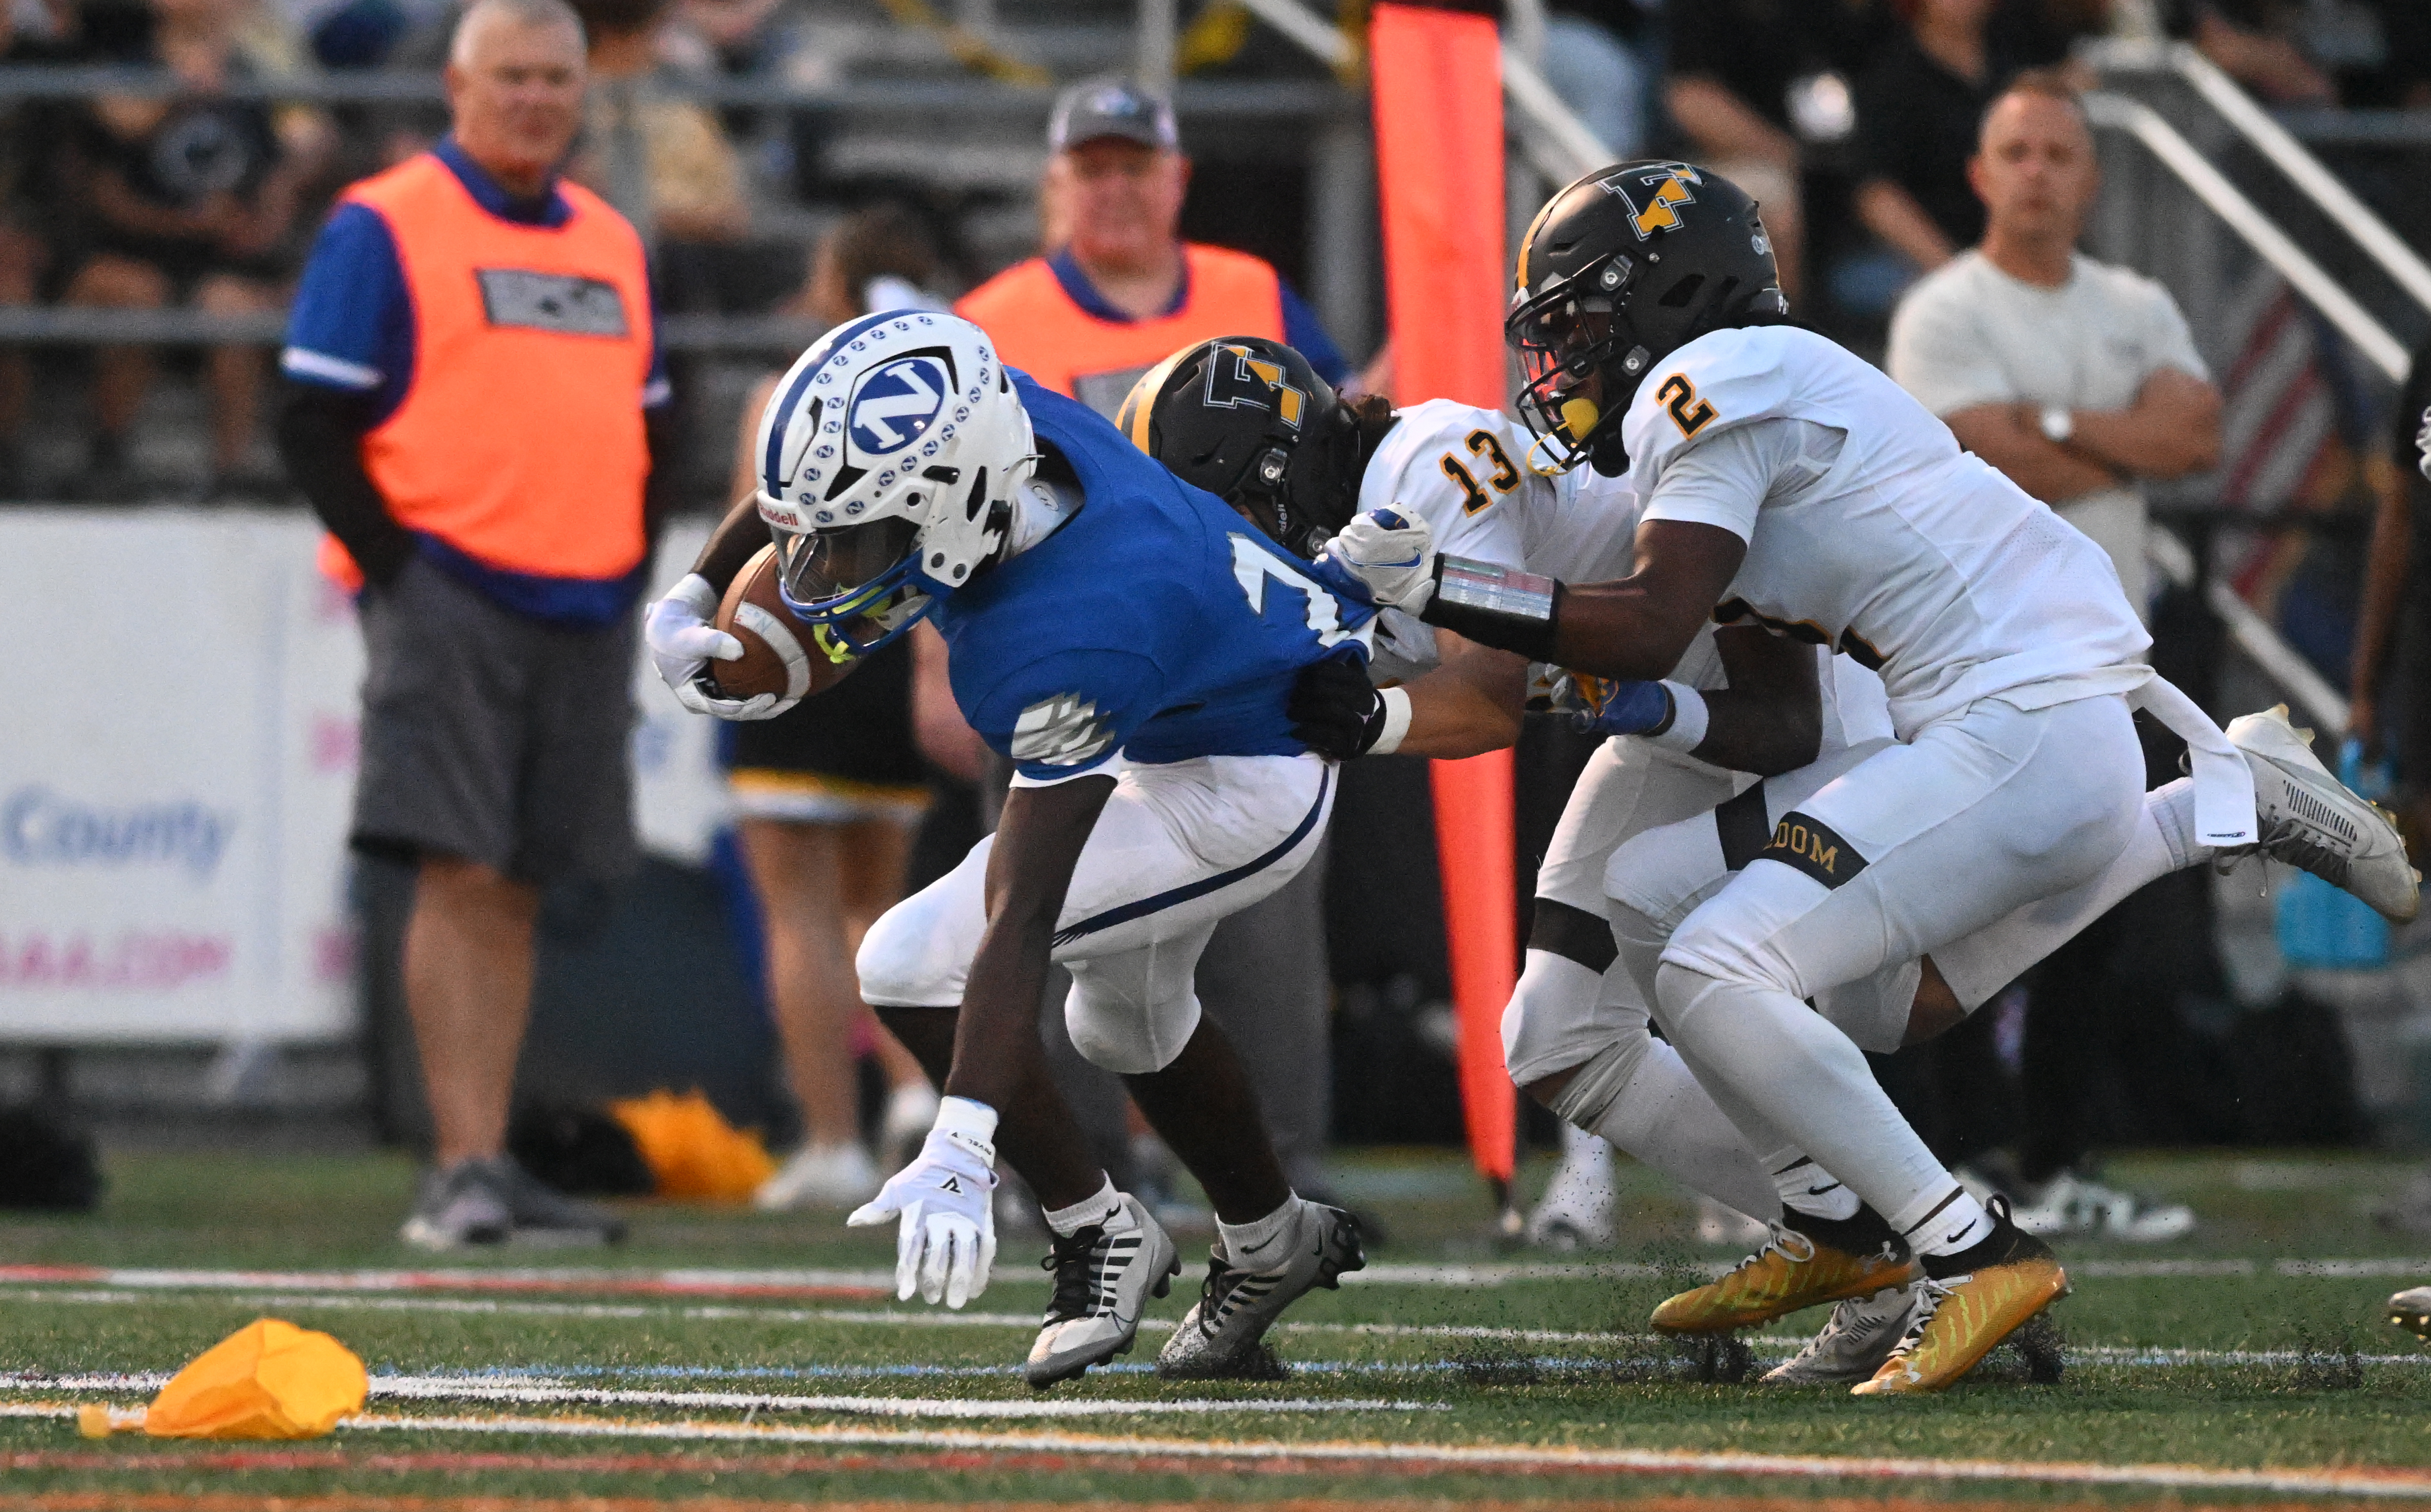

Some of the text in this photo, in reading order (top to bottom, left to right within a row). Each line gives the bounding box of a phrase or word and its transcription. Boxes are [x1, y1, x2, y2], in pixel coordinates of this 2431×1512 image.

[854, 361, 940, 449] N
[1655, 372, 1719, 441] 2
[1439, 428, 1522, 518] 13
[1763, 822, 1838, 874] DOM
